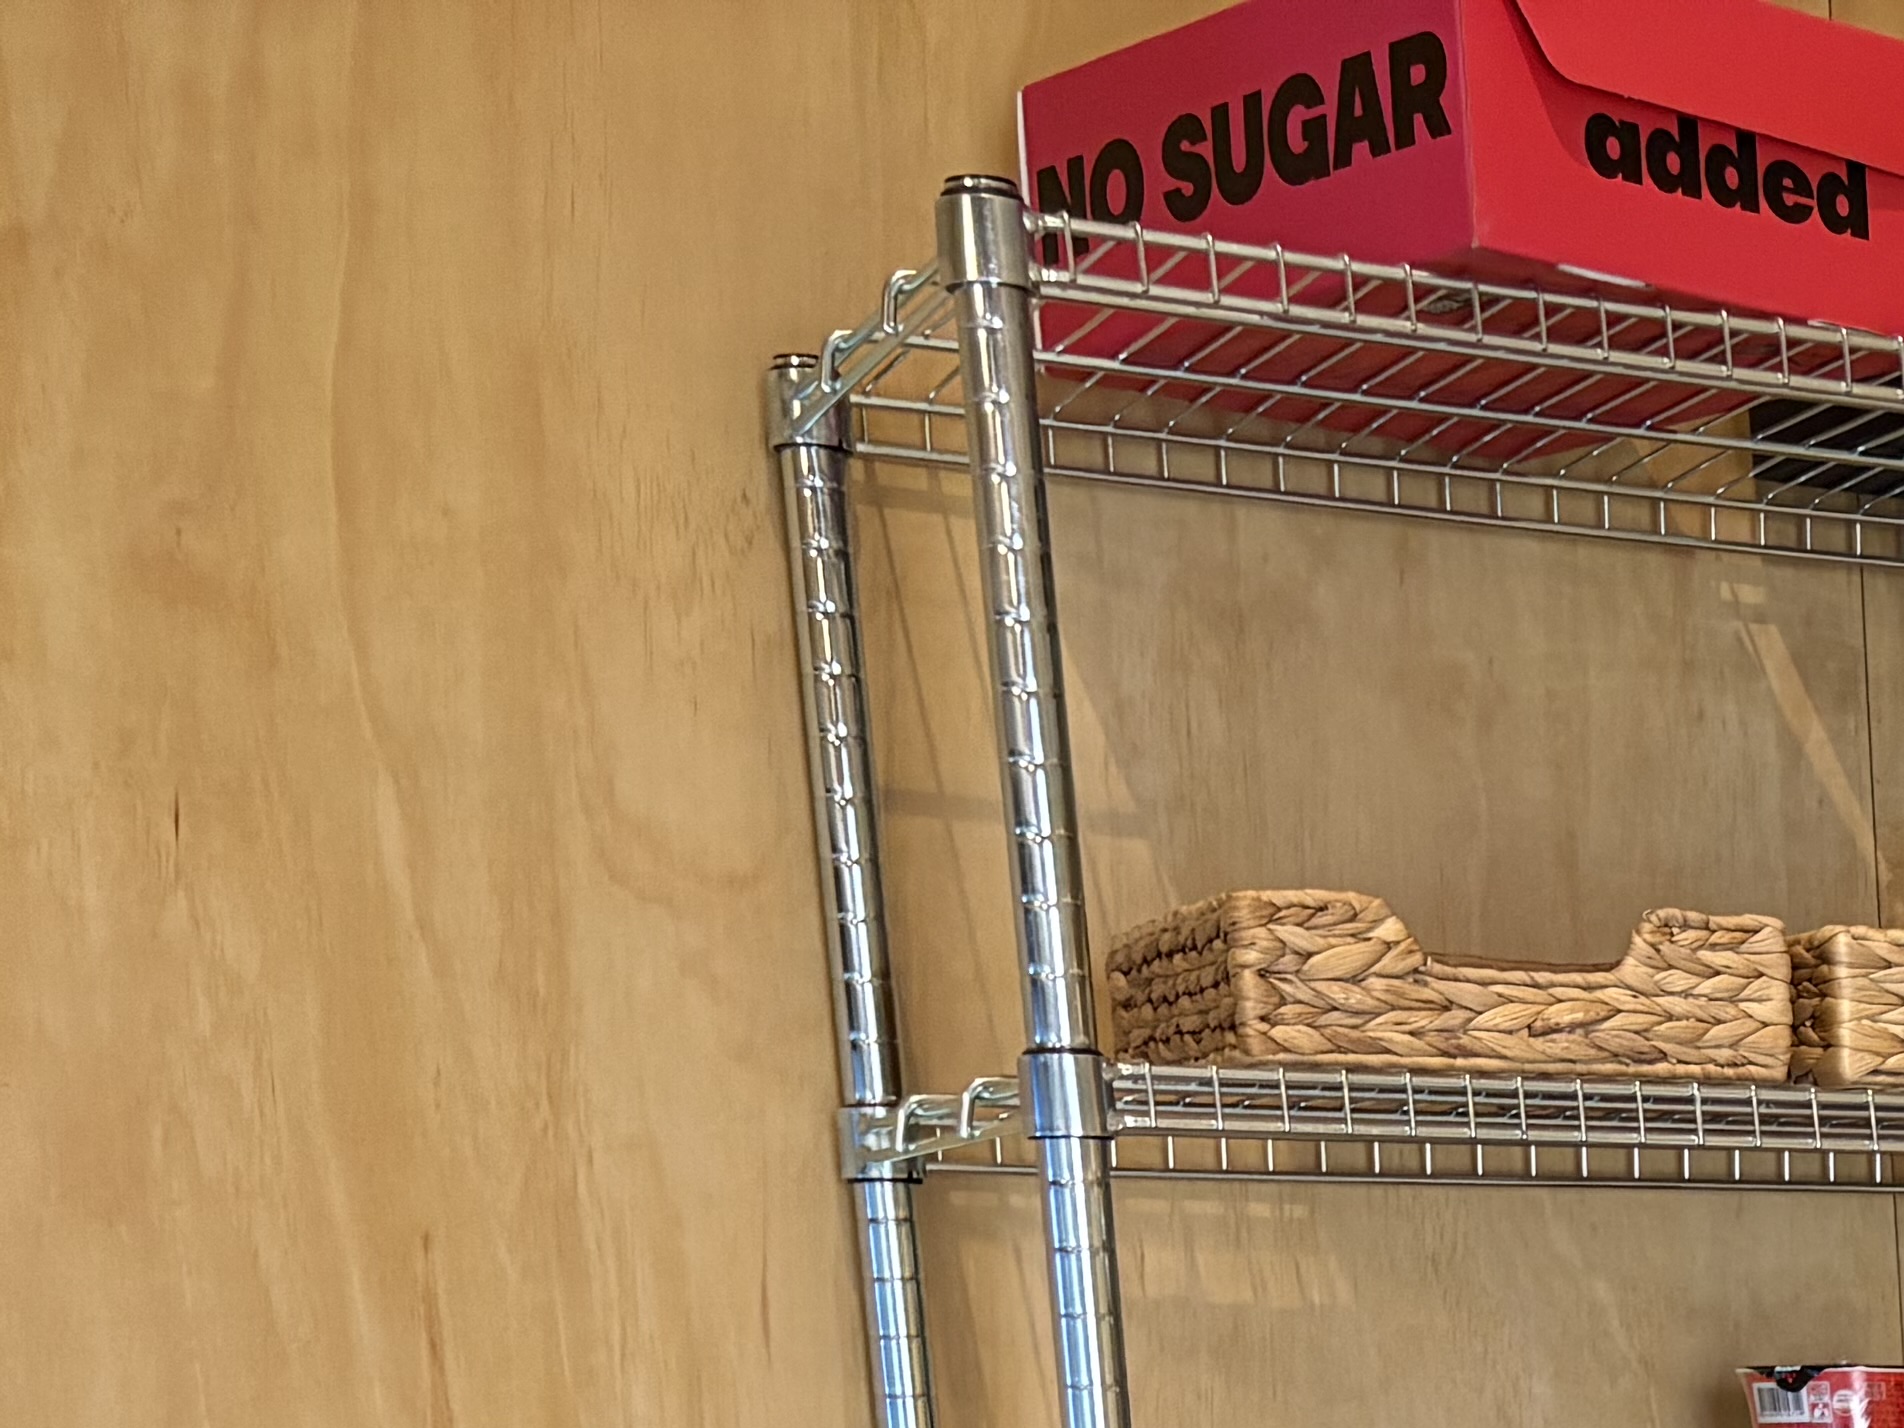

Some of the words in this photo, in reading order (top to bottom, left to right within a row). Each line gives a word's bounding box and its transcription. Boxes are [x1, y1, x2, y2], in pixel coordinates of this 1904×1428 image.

[1036, 139, 1145, 264] NO
[1161, 31, 1451, 222] SUGAR
[1585, 112, 1871, 241] added
